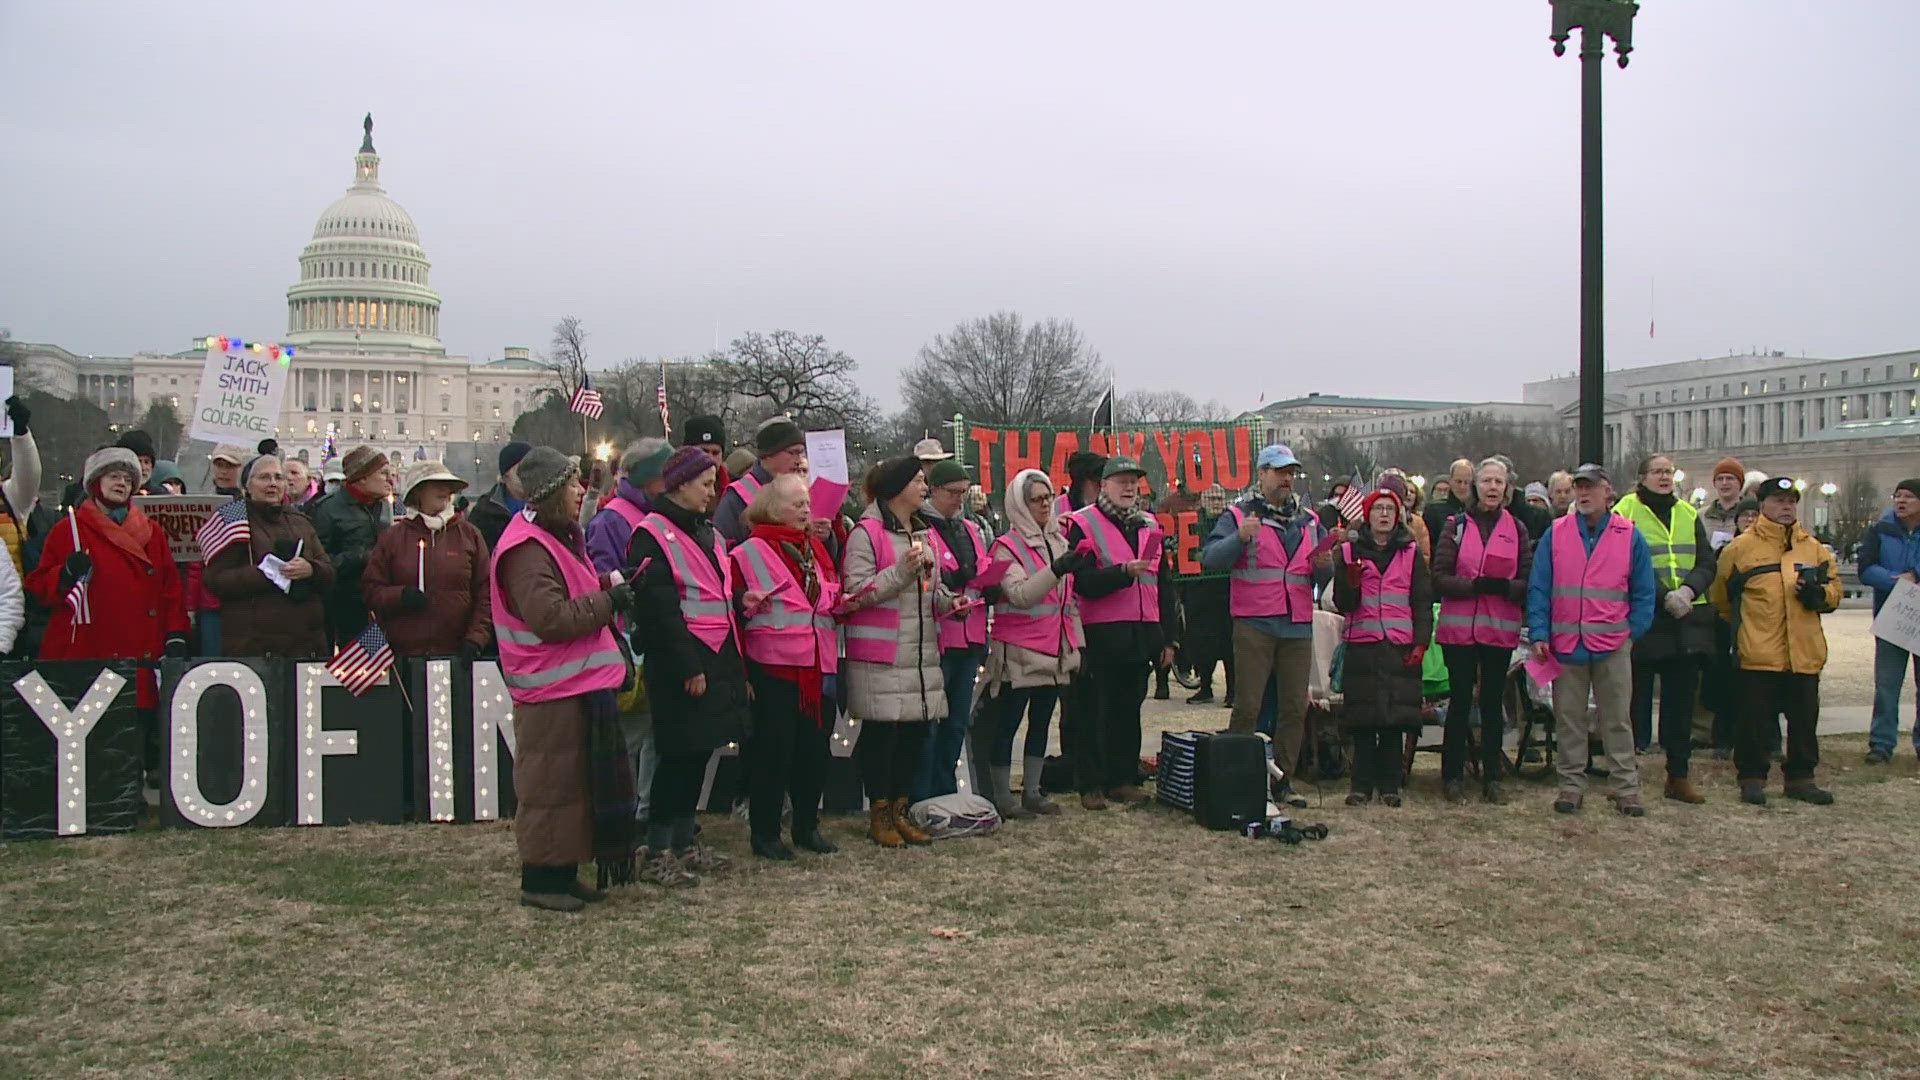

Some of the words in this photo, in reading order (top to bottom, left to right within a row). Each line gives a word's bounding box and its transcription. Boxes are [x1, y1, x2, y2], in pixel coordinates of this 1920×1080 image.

[223, 355, 269, 378] JACK
[218, 373, 270, 396] SMITH
[221, 392, 256, 412] HAS
[201, 407, 269, 433] COURAGE
[1154, 426, 1251, 493] YOU
[144, 503, 212, 514] REPUBLICAN
[149, 514, 209, 541] RUELT
[170, 660, 391, 828] OF
